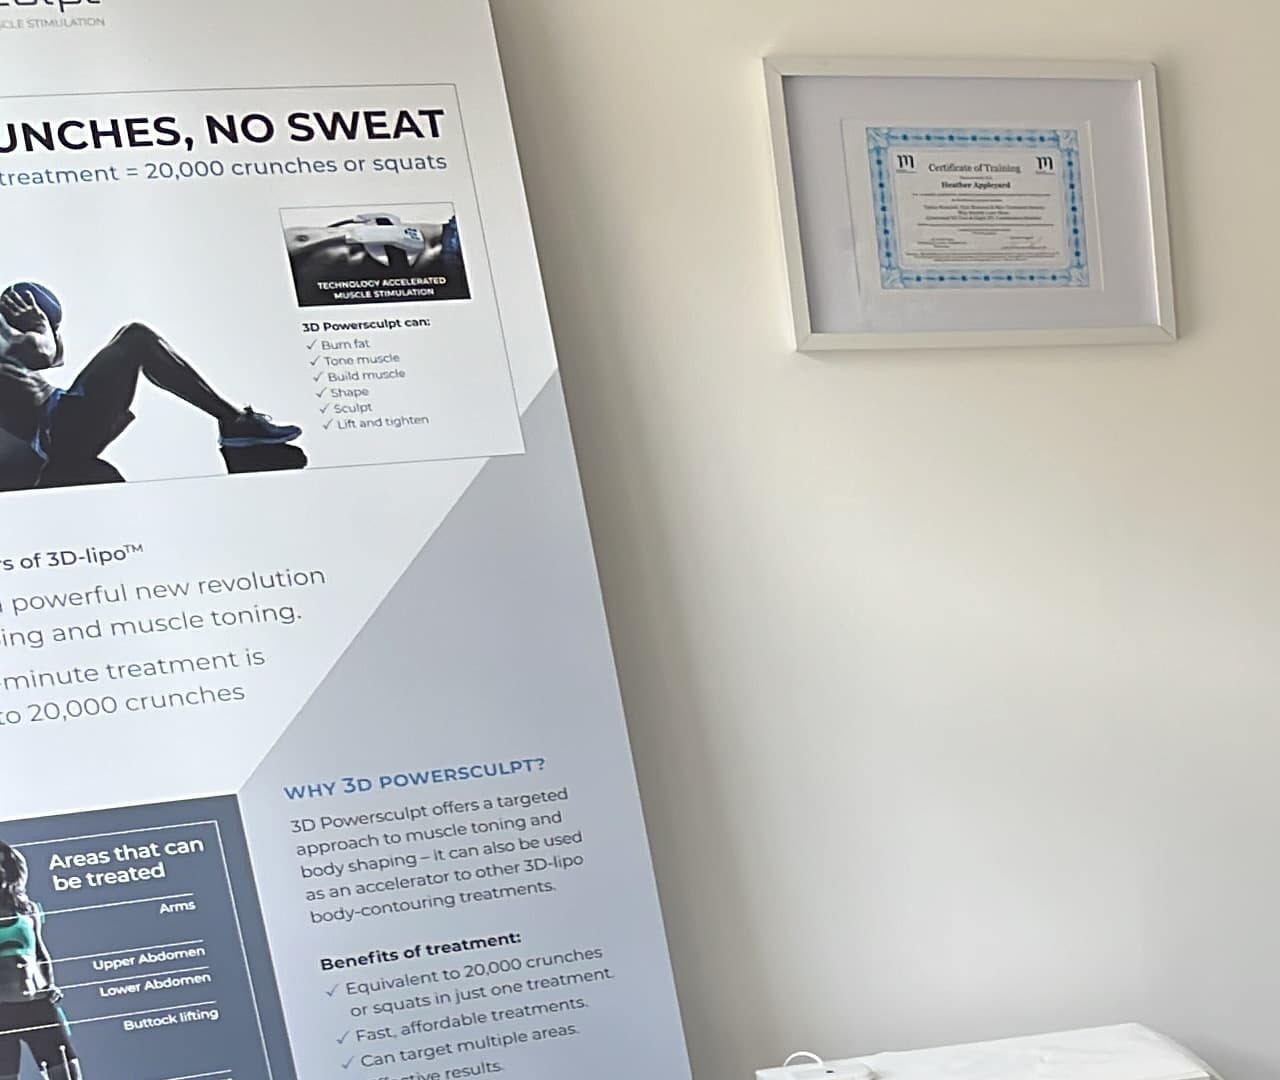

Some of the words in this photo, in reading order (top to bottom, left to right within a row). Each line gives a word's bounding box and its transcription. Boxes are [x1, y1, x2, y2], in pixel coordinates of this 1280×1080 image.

[27, 17, 105, 29] STIMULATION
[206, 113, 274, 145] NO
[288, 109, 444, 142] SWEAT
[0, 166, 119, 187] treatment
[144, 160, 224, 181] 20,000
[231, 156, 338, 176] crunches
[344, 158, 365, 172] or
[373, 155, 447, 174] squats
[317, 280, 380, 290] TECHNOLOGY
[382, 276, 447, 287] ACCELERATED
[333, 290, 372, 300] MUSCLE
[373, 288, 435, 298] STIMULATION
[302, 323, 320, 333] 3D
[323, 319, 402, 332] Powersculpt
[404, 319, 431, 328] can:
[321, 340, 352, 351] Burn
[353, 338, 371, 349] fat
[325, 356, 354, 367] Tone
[356, 353, 401, 365] muscle
[327, 371, 360, 383] Build
[362, 368, 406, 380] muscle
[330, 387, 370, 401] Shape
[333, 403, 373, 416] Sculpt
[337, 419, 356, 430] Lift
[359, 417, 383, 428] and
[385, 415, 430, 430] tighten
[20, 553, 42, 570] of
[12, 584, 127, 617] powerful
[135, 578, 191, 601] new
[198, 568, 326, 595] revolution
[0, 628, 44, 649] ing
[53, 619, 102, 643] and
[110, 611, 204, 637] muscle
[210, 604, 302, 627] toning.
[105, 652, 238, 681] treatment
[245, 648, 266, 668] is
[27, 696, 118, 722] 20,000
[125, 685, 245, 712] crunches
[283, 782, 337, 800] WHY
[342, 776, 373, 795] 3D
[379, 757, 546, 789] POWERSCULPT?
[290, 818, 316, 834] 3D
[320, 806, 428, 831] Powersculpt
[432, 799, 480, 817] offers
[483, 800, 493, 810] a
[497, 787, 569, 811] targeted
[296, 834, 380, 859] approach
[383, 831, 402, 845] to
[405, 823, 468, 843] muscle
[471, 817, 527, 837] toning
[530, 811, 563, 826] and
[48, 850, 111, 871] Areas
[113, 842, 161, 864] that
[163, 838, 204, 856] can
[301, 862, 344, 880] body
[348, 851, 417, 874] shaping
[433, 847, 446, 861] it
[449, 845, 479, 859] can
[482, 839, 515, 854] also
[519, 837, 541, 850] be
[543, 831, 583, 847] used
[52, 874, 83, 893] be
[86, 863, 166, 888] treated
[306, 889, 326, 902] as
[329, 884, 352, 898] an
[355, 871, 450, 894] accelerator
[453, 868, 472, 881] to
[475, 863, 521, 879] other
[523, 853, 584, 873] 3D-lipo
[159, 899, 196, 915] Arms
[310, 895, 456, 924] body-contouring
[459, 882, 557, 904] treatments.
[92, 956, 136, 972] Upper
[138, 945, 206, 965] Abdomen
[320, 950, 399, 972] Benefits
[403, 944, 423, 959] of
[425, 932, 522, 957] treatment:
[99, 981, 141, 998] Lower
[144, 972, 211, 992] Abdomen
[346, 970, 440, 997] Equivalent
[442, 967, 460, 981] to
[463, 959, 522, 979] 20,000
[526, 946, 604, 970] crunches
[350, 1004, 370, 1017] or
[372, 994, 432, 1016] squats
[435, 991, 451, 1005] in
[454, 985, 487, 1005] just
[490, 981, 523, 996] one
[526, 966, 615, 991] treatment.
[123, 1013, 177, 1032] Buttock
[178, 1007, 219, 1024] lifting
[355, 1026, 397, 1043] Fast,
[400, 1010, 488, 1036] affordable
[491, 997, 589, 1023] treatments.
[360, 1051, 396, 1068] Can
[399, 1042, 453, 1062] target
[456, 1031, 529, 1053] multiple
[531, 1024, 581, 1042] areas.
[444, 1060, 505, 1080] results.
